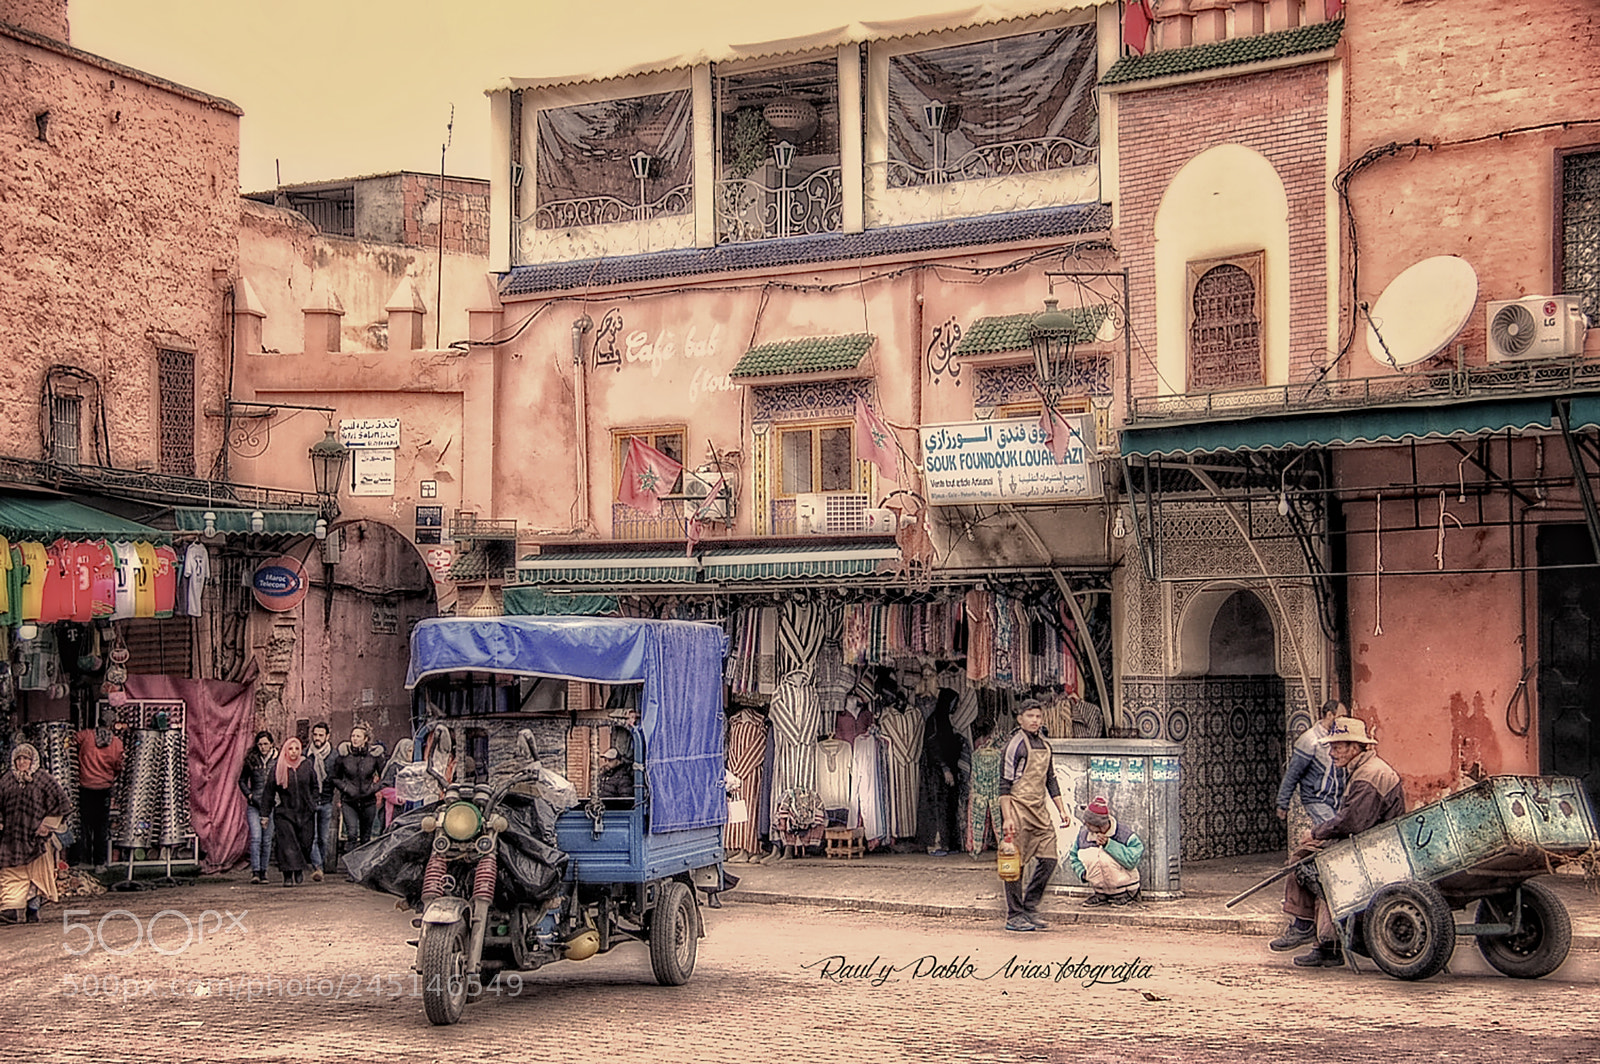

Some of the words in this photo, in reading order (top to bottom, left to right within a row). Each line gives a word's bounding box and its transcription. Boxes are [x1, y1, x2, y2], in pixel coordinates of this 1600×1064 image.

[1544, 318, 1555, 327] LG
[685, 324, 720, 358] bab
[997, 423, 1026, 449] فندق
[926, 454, 957, 472] SOUK
[959, 449, 1018, 470] FOUNDOUK
[1018, 447, 1084, 467] LOUARAZI
[259, 580, 286, 588] Telecom
[265, 574, 286, 582] Maroc
